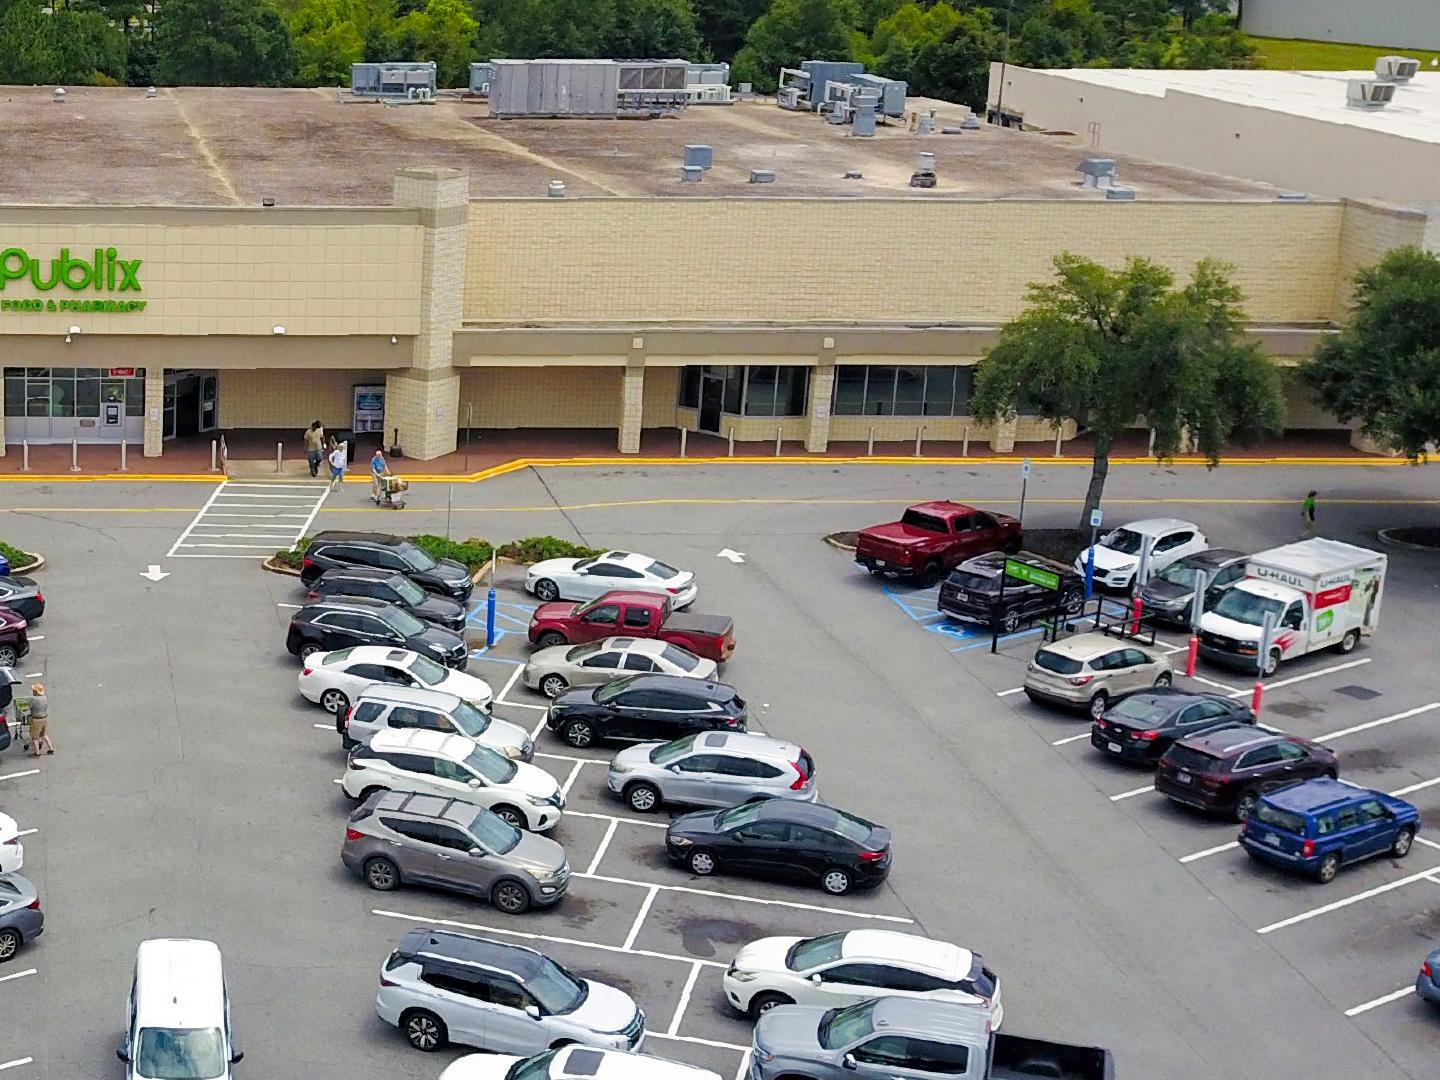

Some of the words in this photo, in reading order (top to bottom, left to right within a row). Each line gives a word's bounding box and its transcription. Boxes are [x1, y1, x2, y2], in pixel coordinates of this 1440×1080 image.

[0, 299, 44, 312] FOOD
[46, 299, 57, 312] &
[60, 299, 148, 313] PHARMACY
